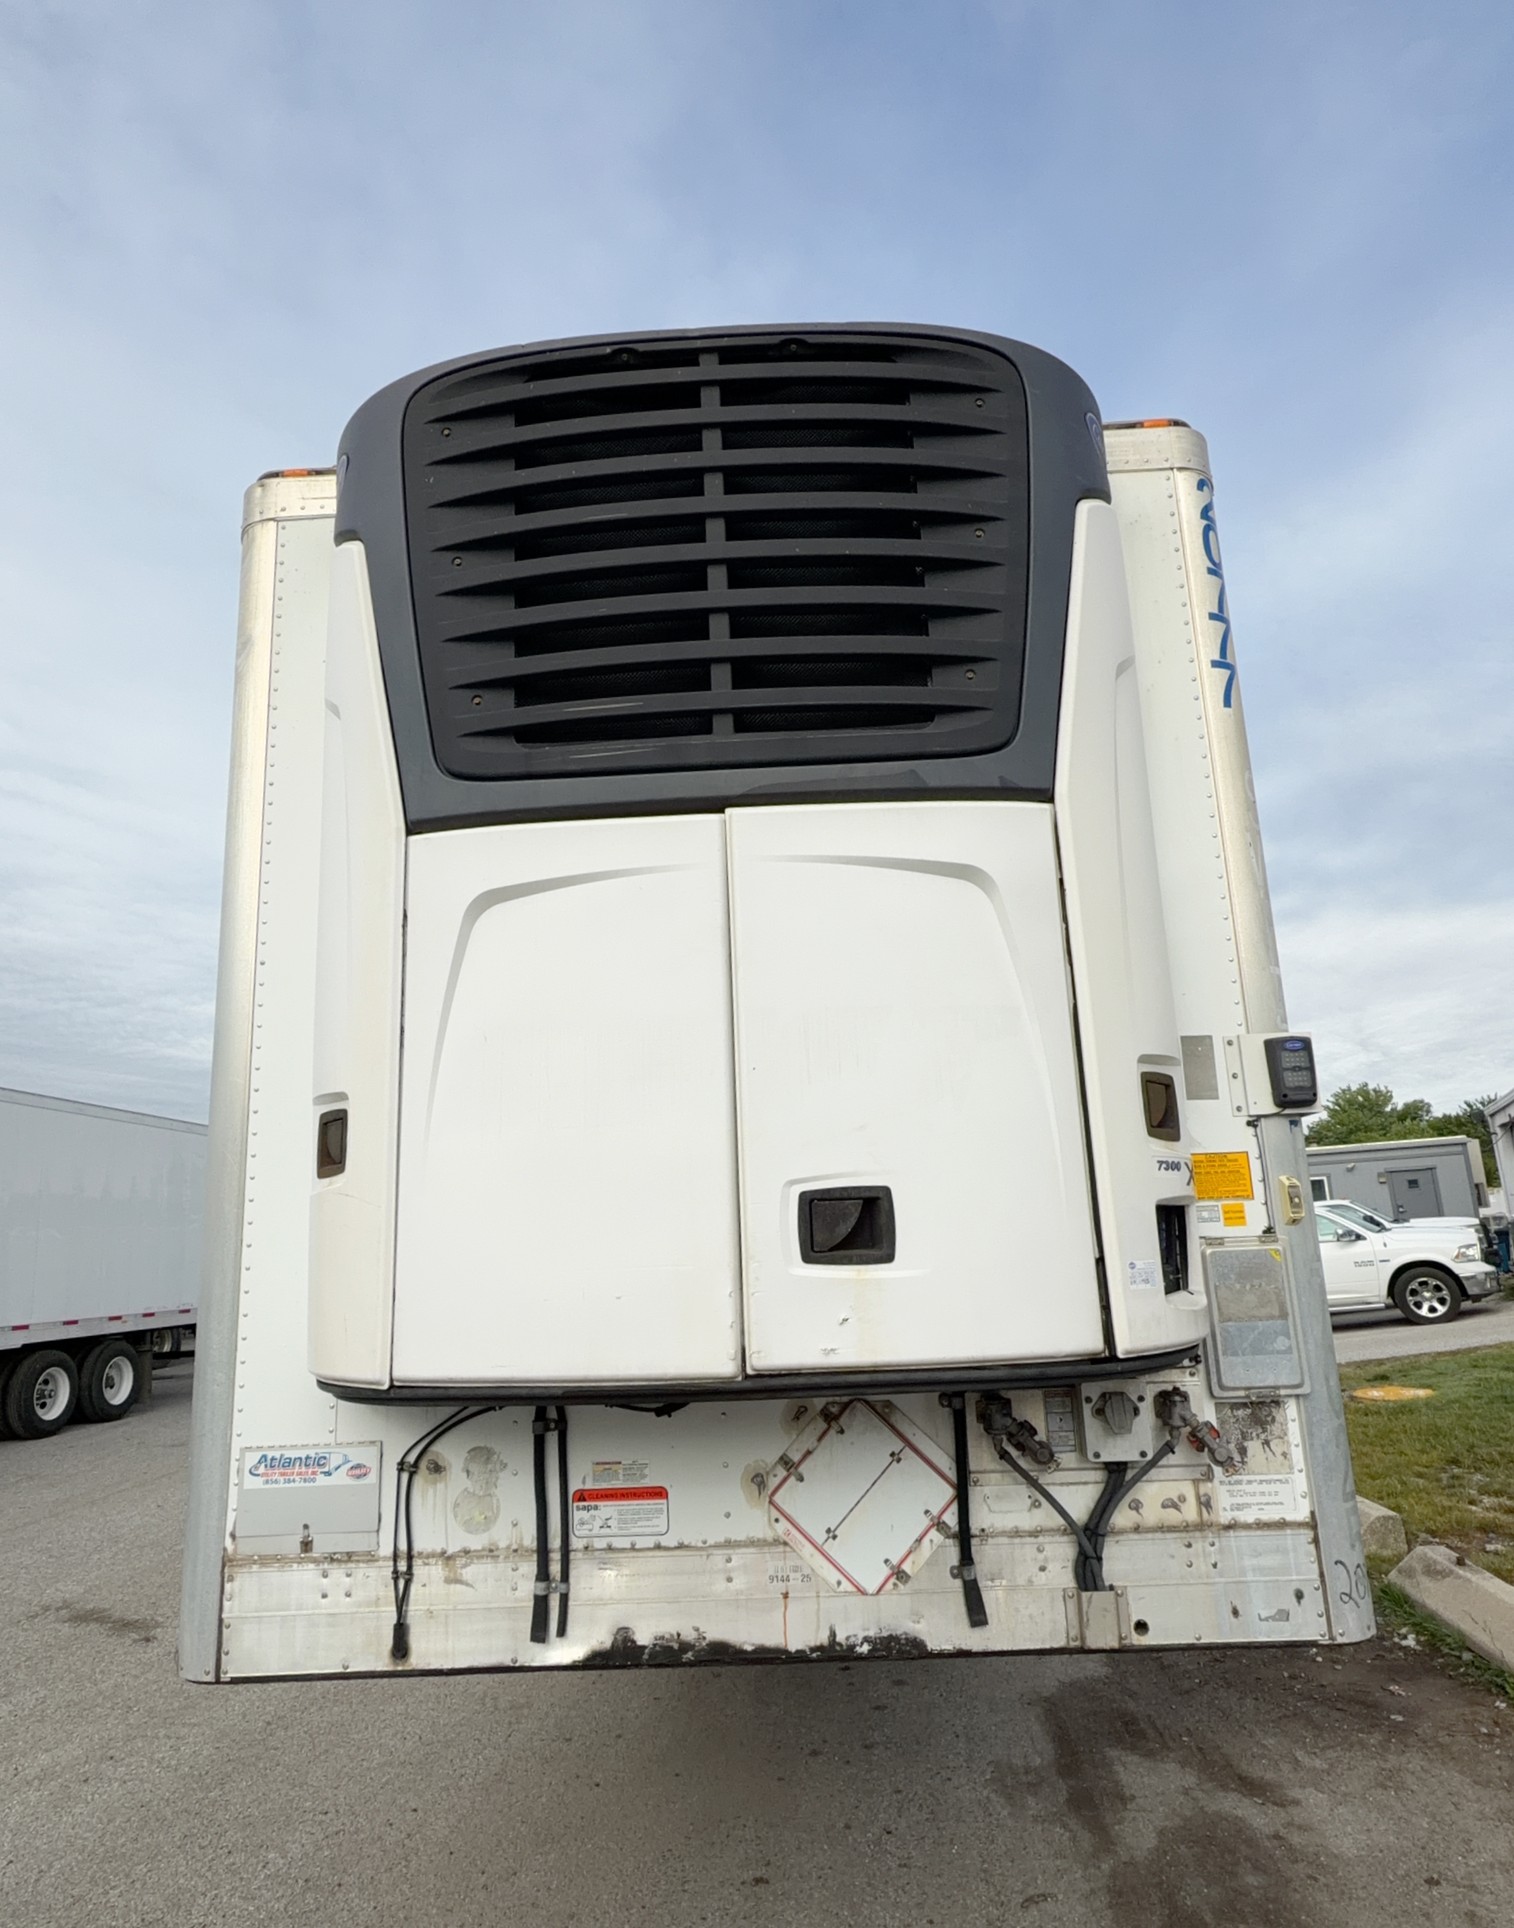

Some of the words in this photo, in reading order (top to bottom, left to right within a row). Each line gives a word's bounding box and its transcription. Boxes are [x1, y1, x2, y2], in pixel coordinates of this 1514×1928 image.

[1157, 1160, 1182, 1172] 7300
[256, 1452, 328, 1470] Atlantic
[263, 1478, 281, 1487] (856)
[282, 1476, 317, 1486] 384-7800
[588, 1492, 618, 1500] CLEANING
[619, 1490, 663, 1499] INSTRUCTIONS
